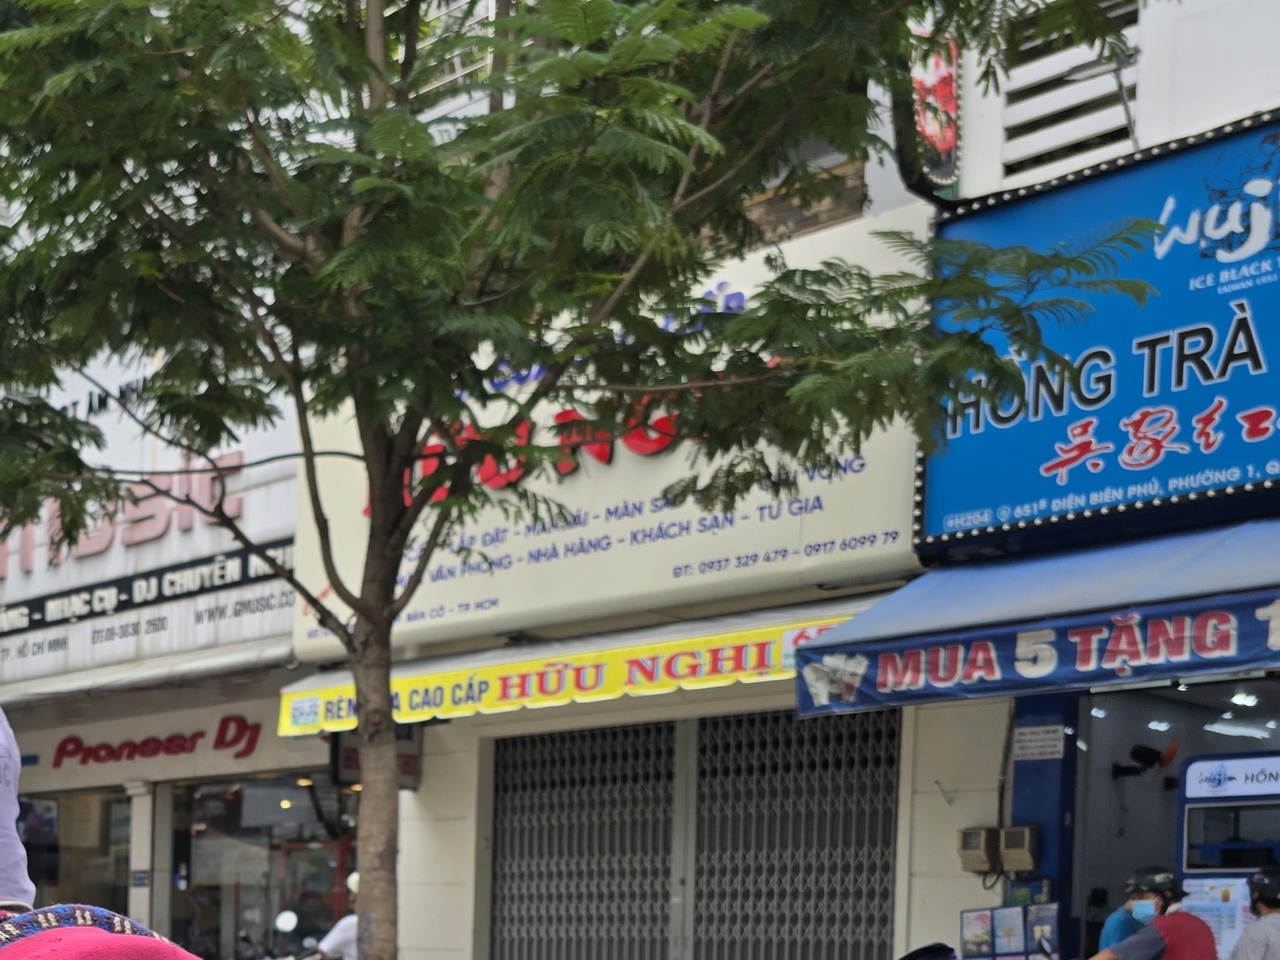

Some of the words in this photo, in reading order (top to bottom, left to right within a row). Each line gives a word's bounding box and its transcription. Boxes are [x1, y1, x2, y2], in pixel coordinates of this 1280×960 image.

[1219, 259, 1272, 283] BLACK
[1131, 299, 1268, 398] TRÀ
[630, 519, 692, 546] KHÁCH
[697, 510, 735, 535] SẠN
[787, 495, 824, 517] GIA
[132, 576, 159, 604] DJ
[162, 554, 242, 598] CHUYÊN
[409, 685, 444, 711] CAO
[451, 673, 489, 706] CẤP
[497, 661, 608, 701] HỮU
[624, 640, 777, 686] NGHỊ
[876, 640, 1002, 694] MUA
[1014, 629, 1059, 679] 5
[1067, 611, 1238, 677] TẶNG
[52, 732, 207, 769] Pioneer
